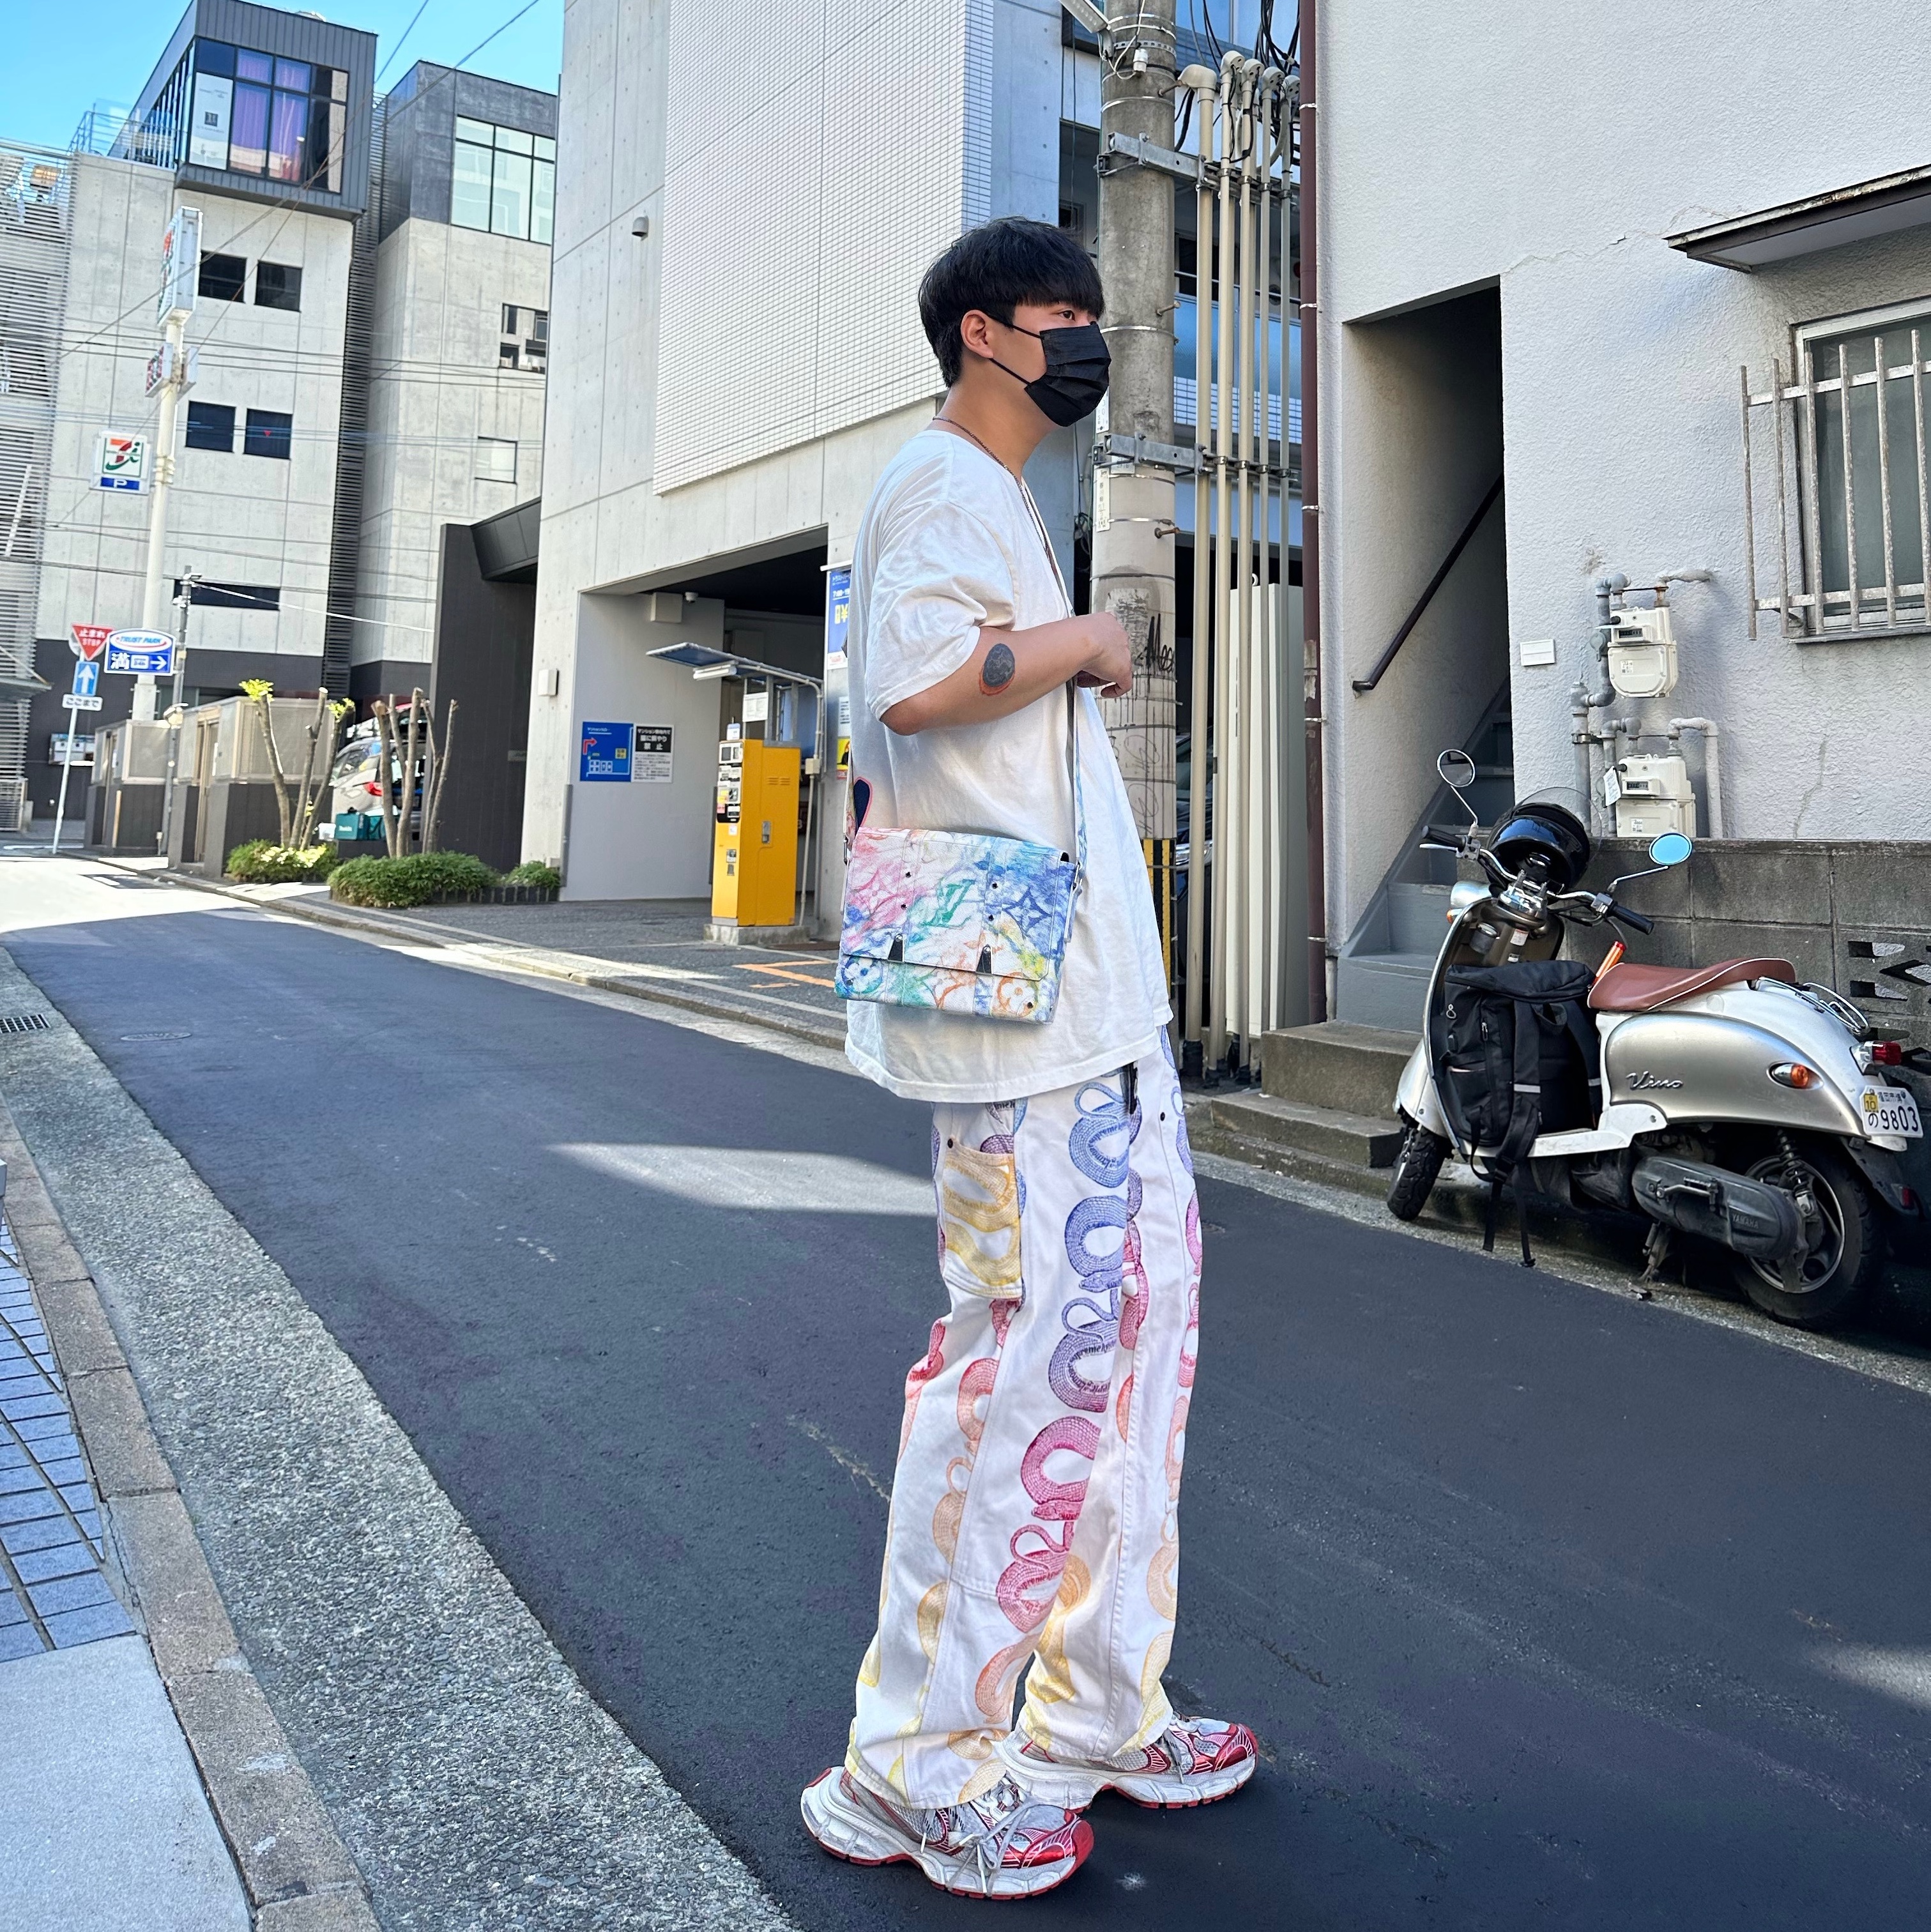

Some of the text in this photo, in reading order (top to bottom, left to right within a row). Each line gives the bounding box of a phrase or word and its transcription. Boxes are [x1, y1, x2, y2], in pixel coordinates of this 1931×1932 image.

[113, 478, 128, 489] P
[78, 628, 106, 638] 止まれ
[82, 637, 102, 646] STOP
[111, 653, 130, 669] 満
[66, 697, 100, 708] ここまで
[1626, 1070, 1683, 1090] Vino
[1866, 1100, 1877, 1110] 10
[1868, 1106, 1919, 1132] の 9803
[1732, 1213, 1759, 1229] YAMAHA
